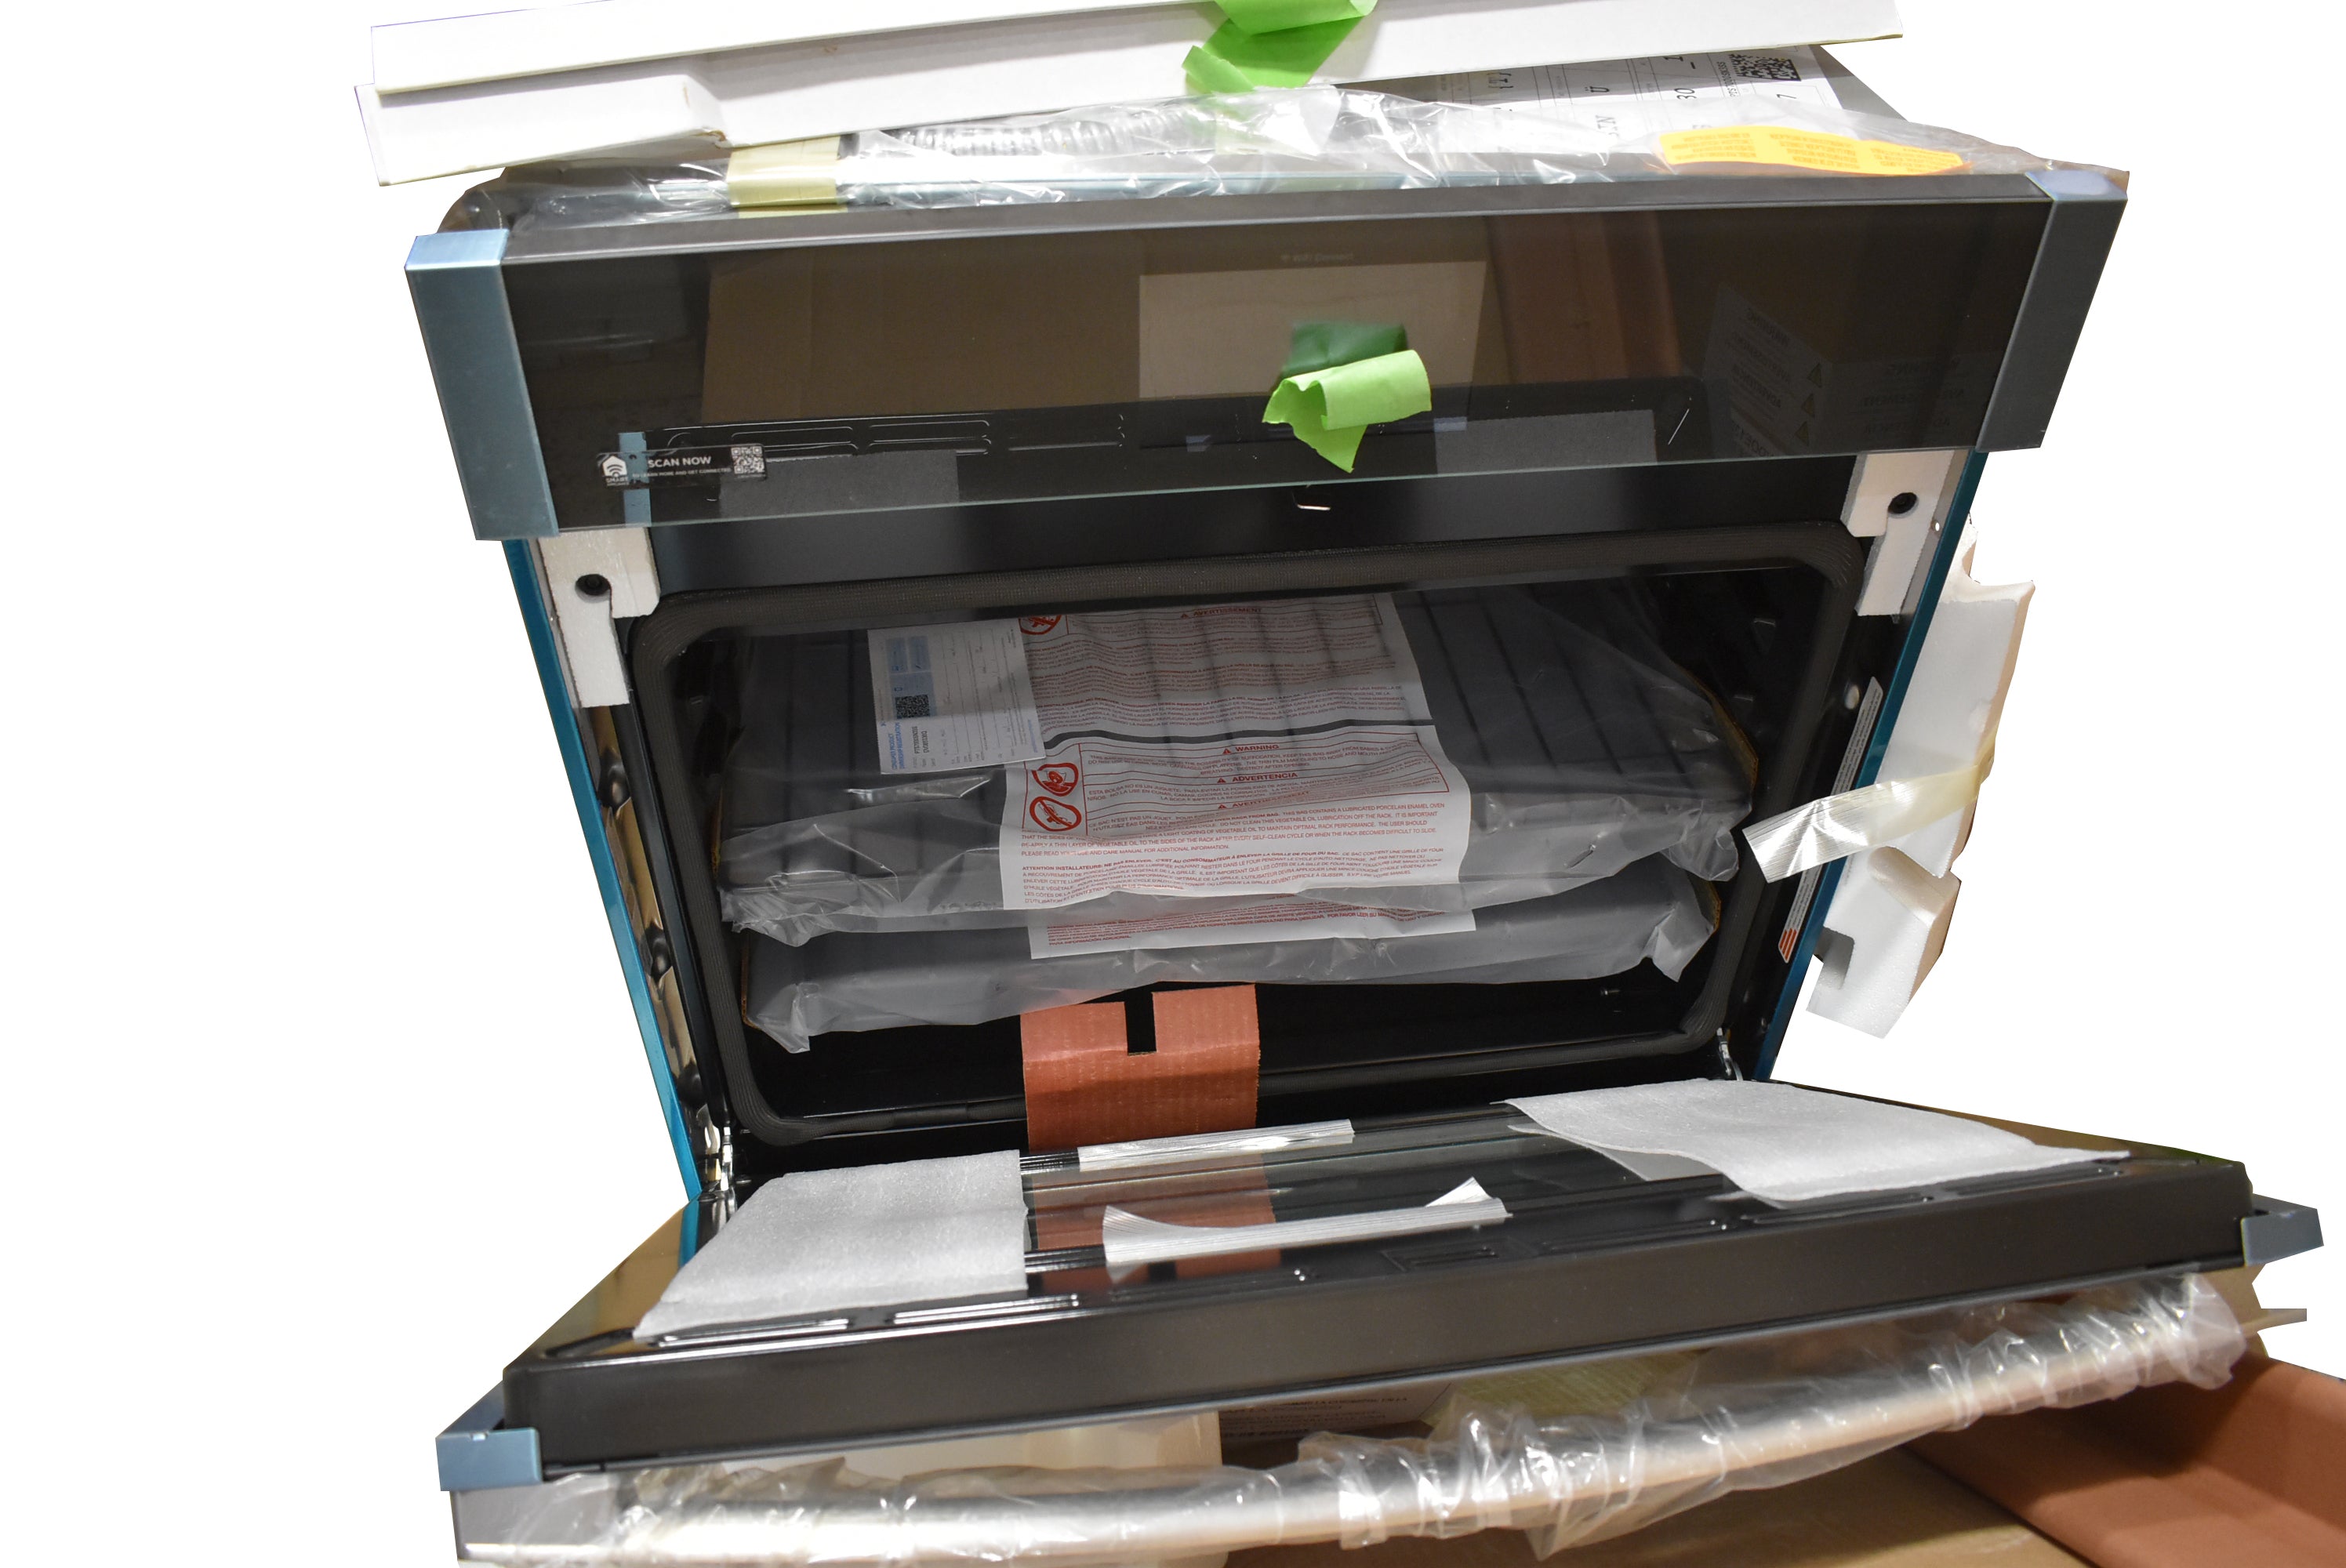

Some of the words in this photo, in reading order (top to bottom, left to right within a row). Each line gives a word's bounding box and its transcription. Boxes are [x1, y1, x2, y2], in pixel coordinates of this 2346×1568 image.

[648, 459, 679, 468] SCAN
[682, 456, 711, 465] NOW
[1232, 772, 1298, 782] ADVERTENCIA
[1240, 871, 1277, 880] L'UTILISATEUR
